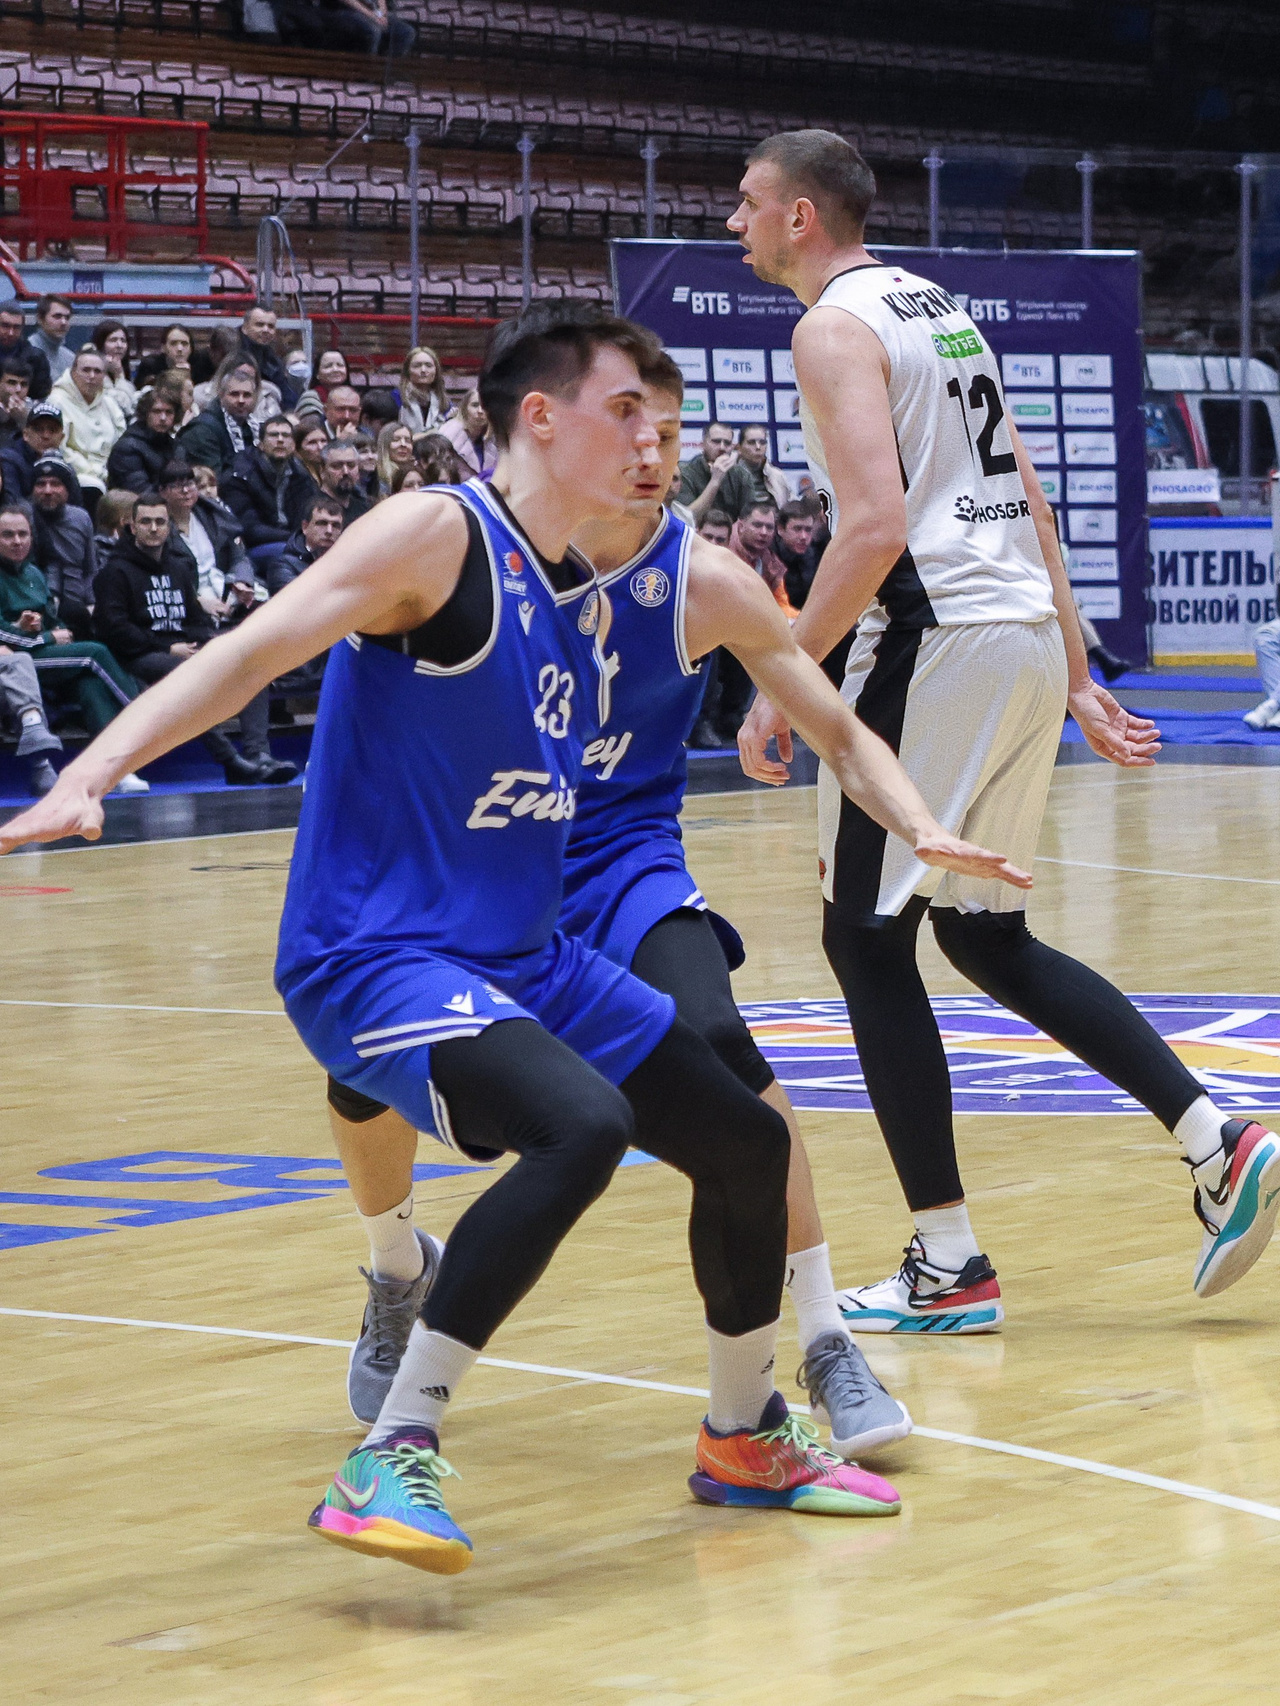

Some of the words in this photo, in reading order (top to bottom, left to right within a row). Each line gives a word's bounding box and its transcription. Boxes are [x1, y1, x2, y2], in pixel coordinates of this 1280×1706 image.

[691, 291, 731, 315] ВТБ
[970, 299, 1011, 321] ВТБ
[732, 362, 753, 374] ВТБ
[1021, 366, 1041, 378] ВТБ
[947, 374, 1018, 477] 12
[1152, 484, 1212, 495] PHOSAGRO
[1149, 551, 1274, 587] ИТЕЛЬ
[534, 664, 575, 739] 23
[581, 732, 633, 780] ey
